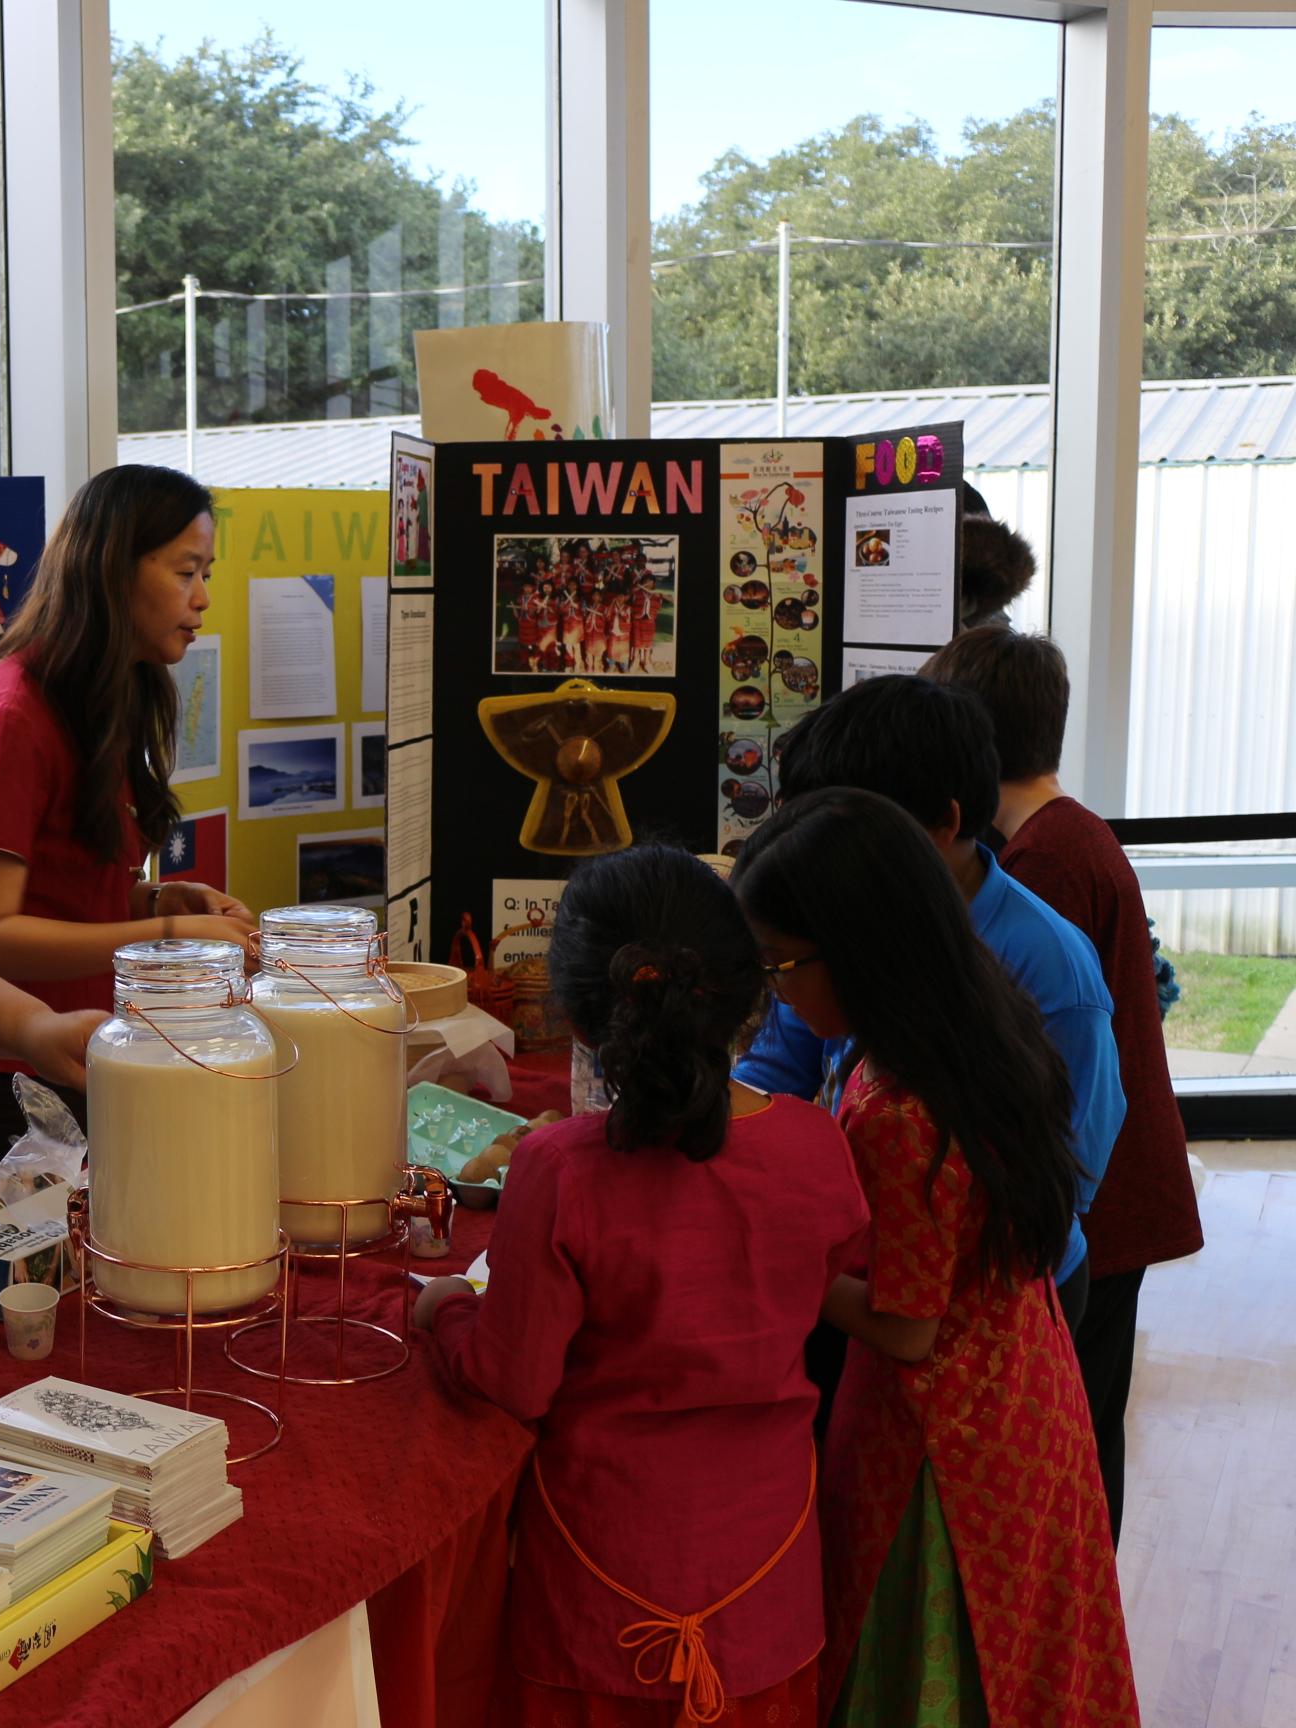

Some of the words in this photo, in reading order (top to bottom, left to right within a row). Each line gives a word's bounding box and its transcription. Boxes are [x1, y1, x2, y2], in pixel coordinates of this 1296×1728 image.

[856, 435, 944, 490] FOOD
[472, 460, 703, 515] TAIWAN
[924, 505, 944, 513] Recipes
[214, 507, 379, 562] TAIW
[504, 897, 520, 911] Q:
[525, 898, 537, 910] In
[542, 898, 561, 911] Ta
[504, 951, 547, 962] entert
[128, 1415, 213, 1458] TAIWAN
[0, 1649, 11, 1662] Gift
